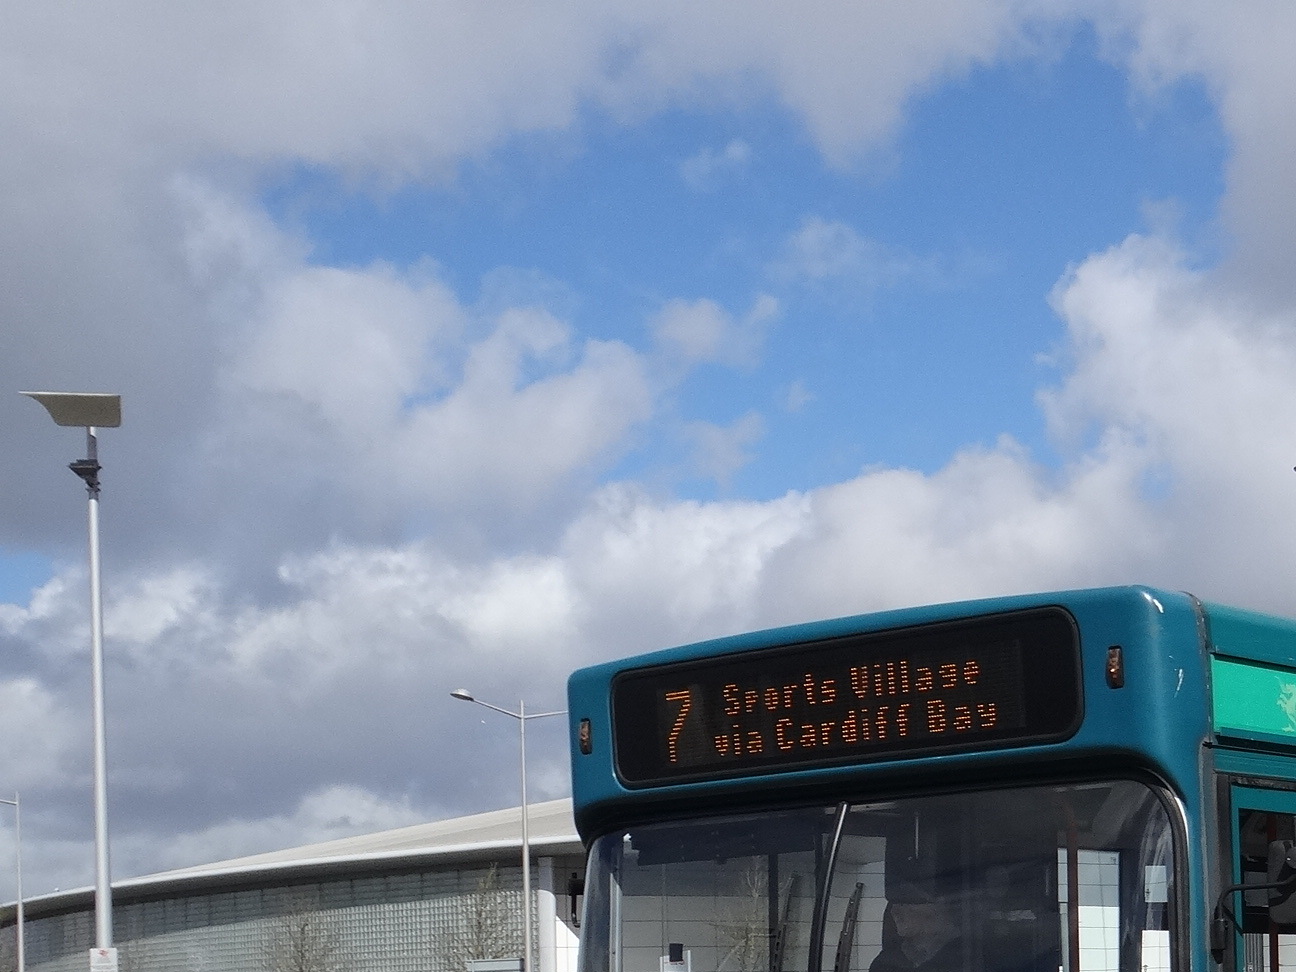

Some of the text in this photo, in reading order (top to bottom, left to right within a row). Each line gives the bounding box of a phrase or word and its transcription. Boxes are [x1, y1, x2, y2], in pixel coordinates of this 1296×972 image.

[723, 659, 980, 716] Sports Village
[665, 690, 690, 762] 7
[714, 698, 997, 757] via Cardiff Bay
